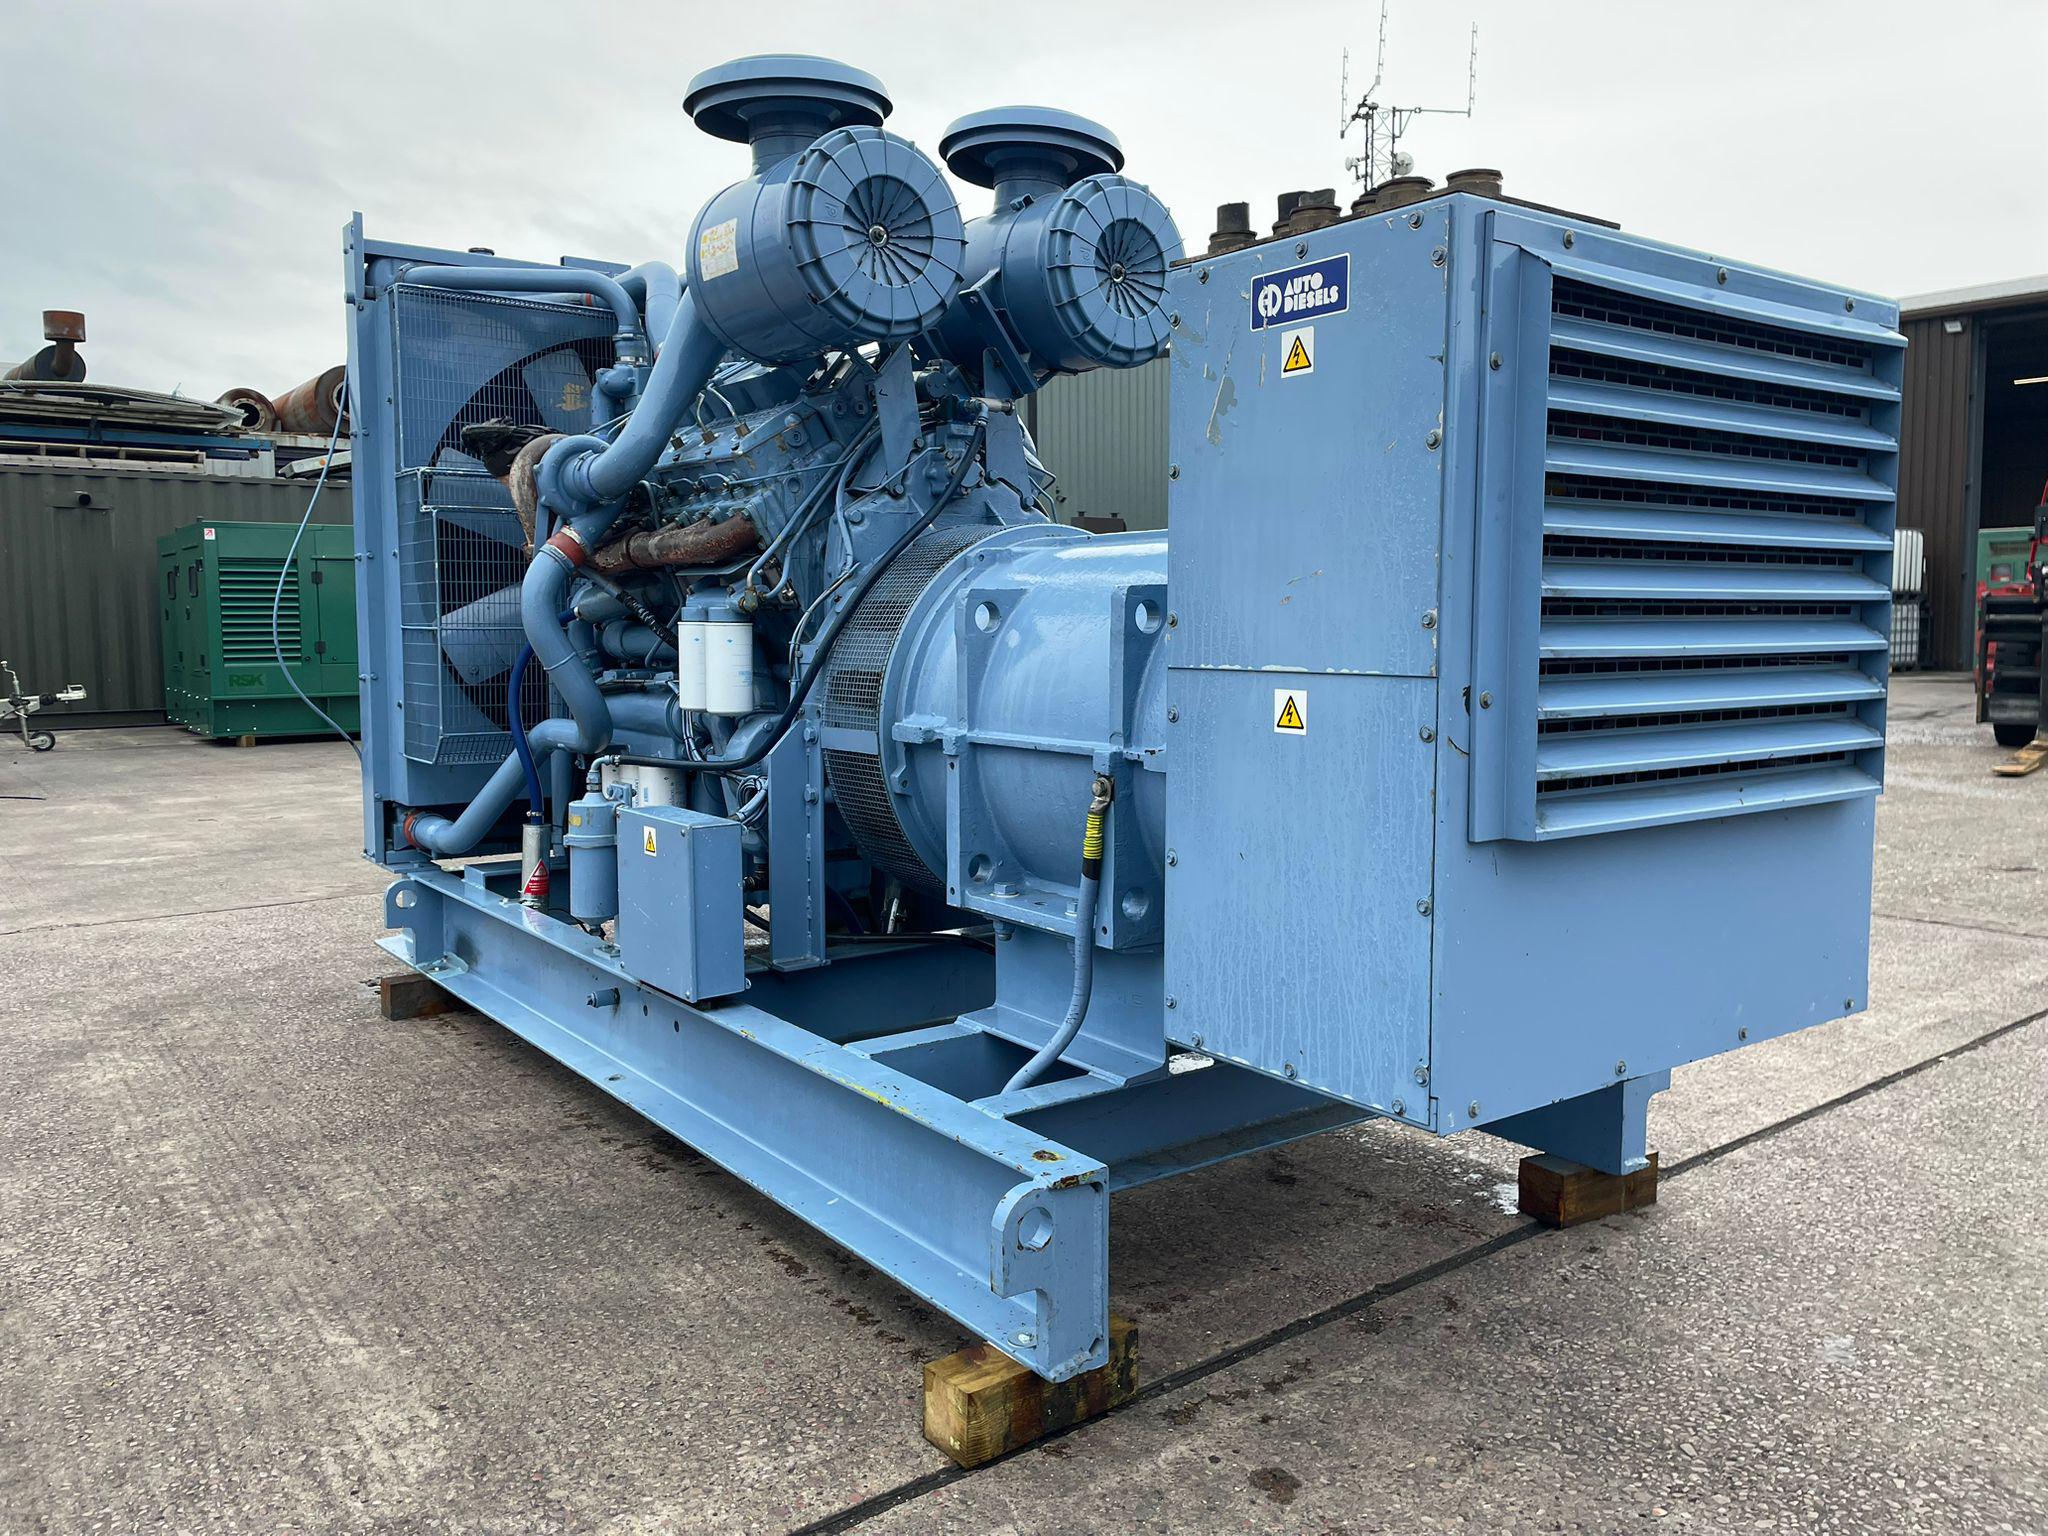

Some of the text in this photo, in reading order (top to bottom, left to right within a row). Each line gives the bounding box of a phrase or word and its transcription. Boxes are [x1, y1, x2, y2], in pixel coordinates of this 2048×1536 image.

[1284, 272, 1323, 296] AUTO
[1284, 285, 1338, 313] DIESELS
[229, 674, 264, 687] RSK
